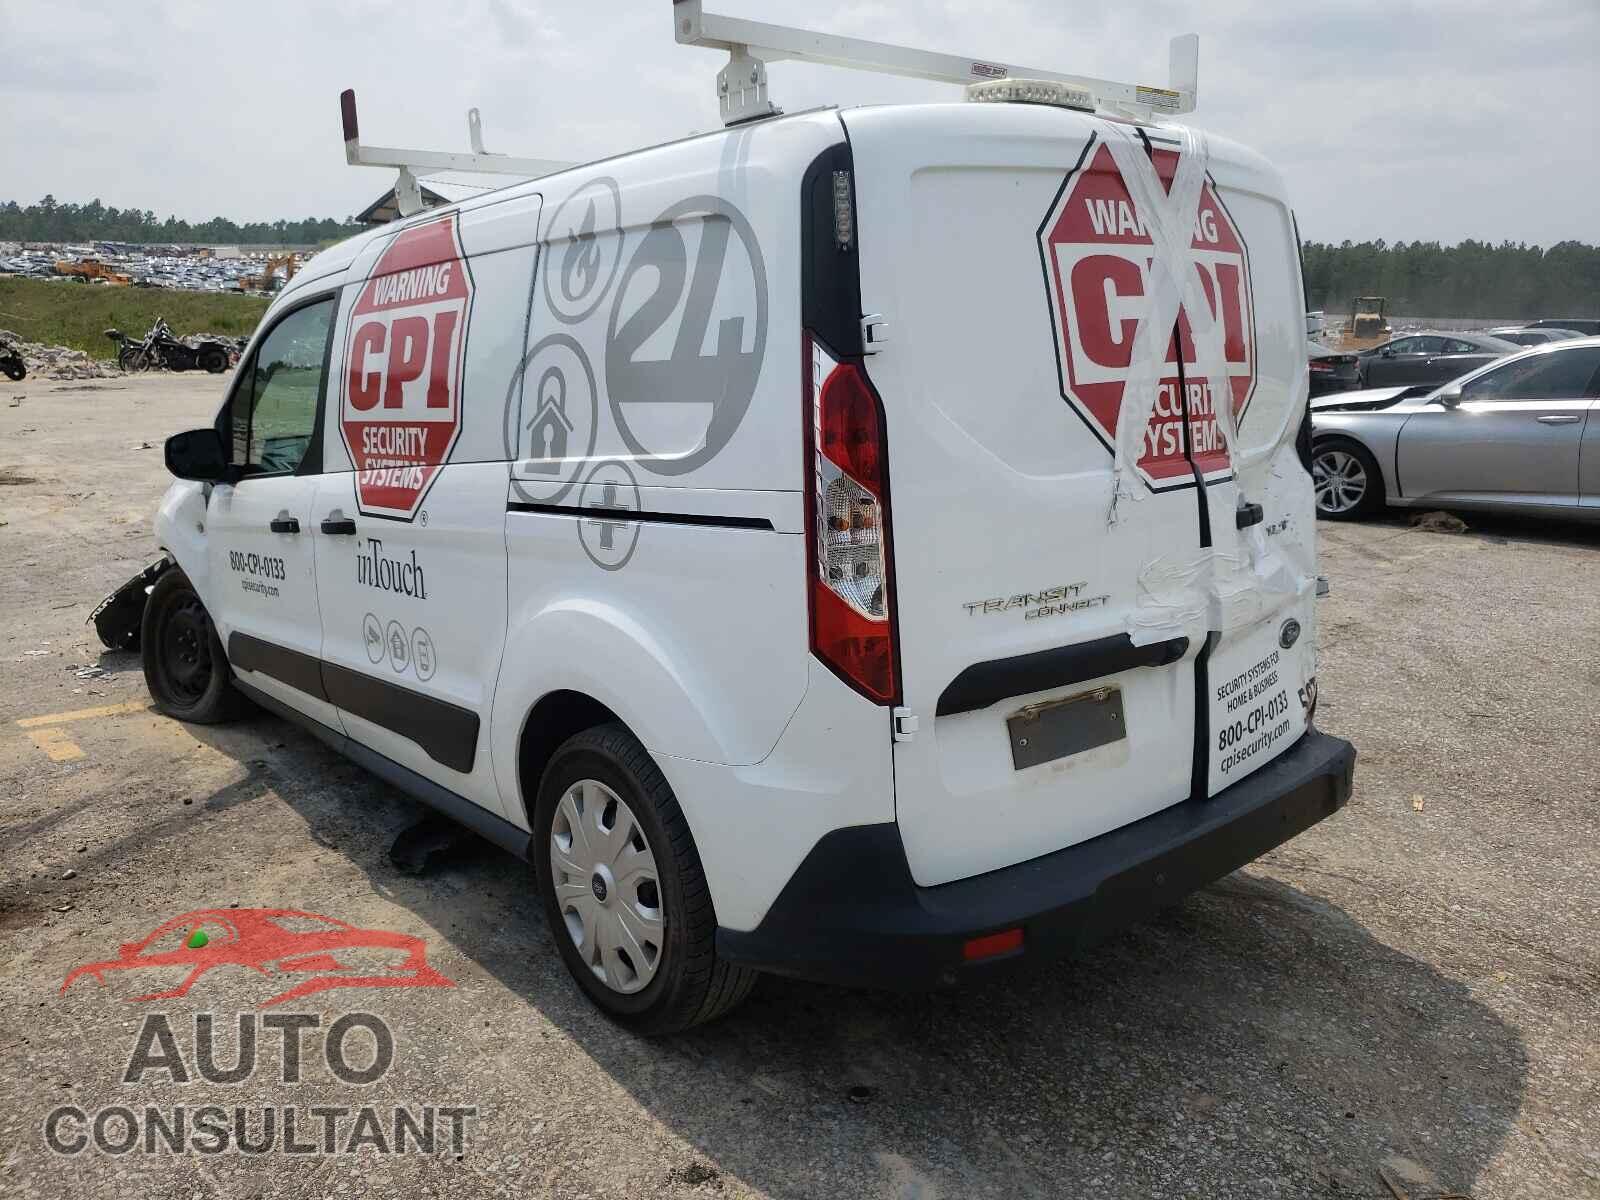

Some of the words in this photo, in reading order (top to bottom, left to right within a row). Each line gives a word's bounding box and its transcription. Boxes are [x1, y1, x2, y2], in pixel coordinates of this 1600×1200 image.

[373, 262, 450, 306] WARNING
[349, 310, 459, 411] CPI
[1136, 382, 1217, 419] CURIT
[362, 426, 428, 457] SECURITY
[361, 458, 426, 490] SYSTEMS
[229, 550, 286, 581] 800-CPI-0133
[356, 538, 427, 600] inTouch
[962, 581, 1088, 616] TRANSIT
[1024, 595, 1112, 621] CONNECT
[1217, 669, 1248, 701] SECURITY
[1248, 656, 1270, 683] SYSTEMS
[1270, 650, 1280, 667] FOR
[1227, 688, 1248, 713] HOME
[1253, 670, 1278, 697] BUSINESS
[1218, 689, 1289, 752] 800-CPI-0133
[1220, 719, 1291, 774] cpisecurity.com
